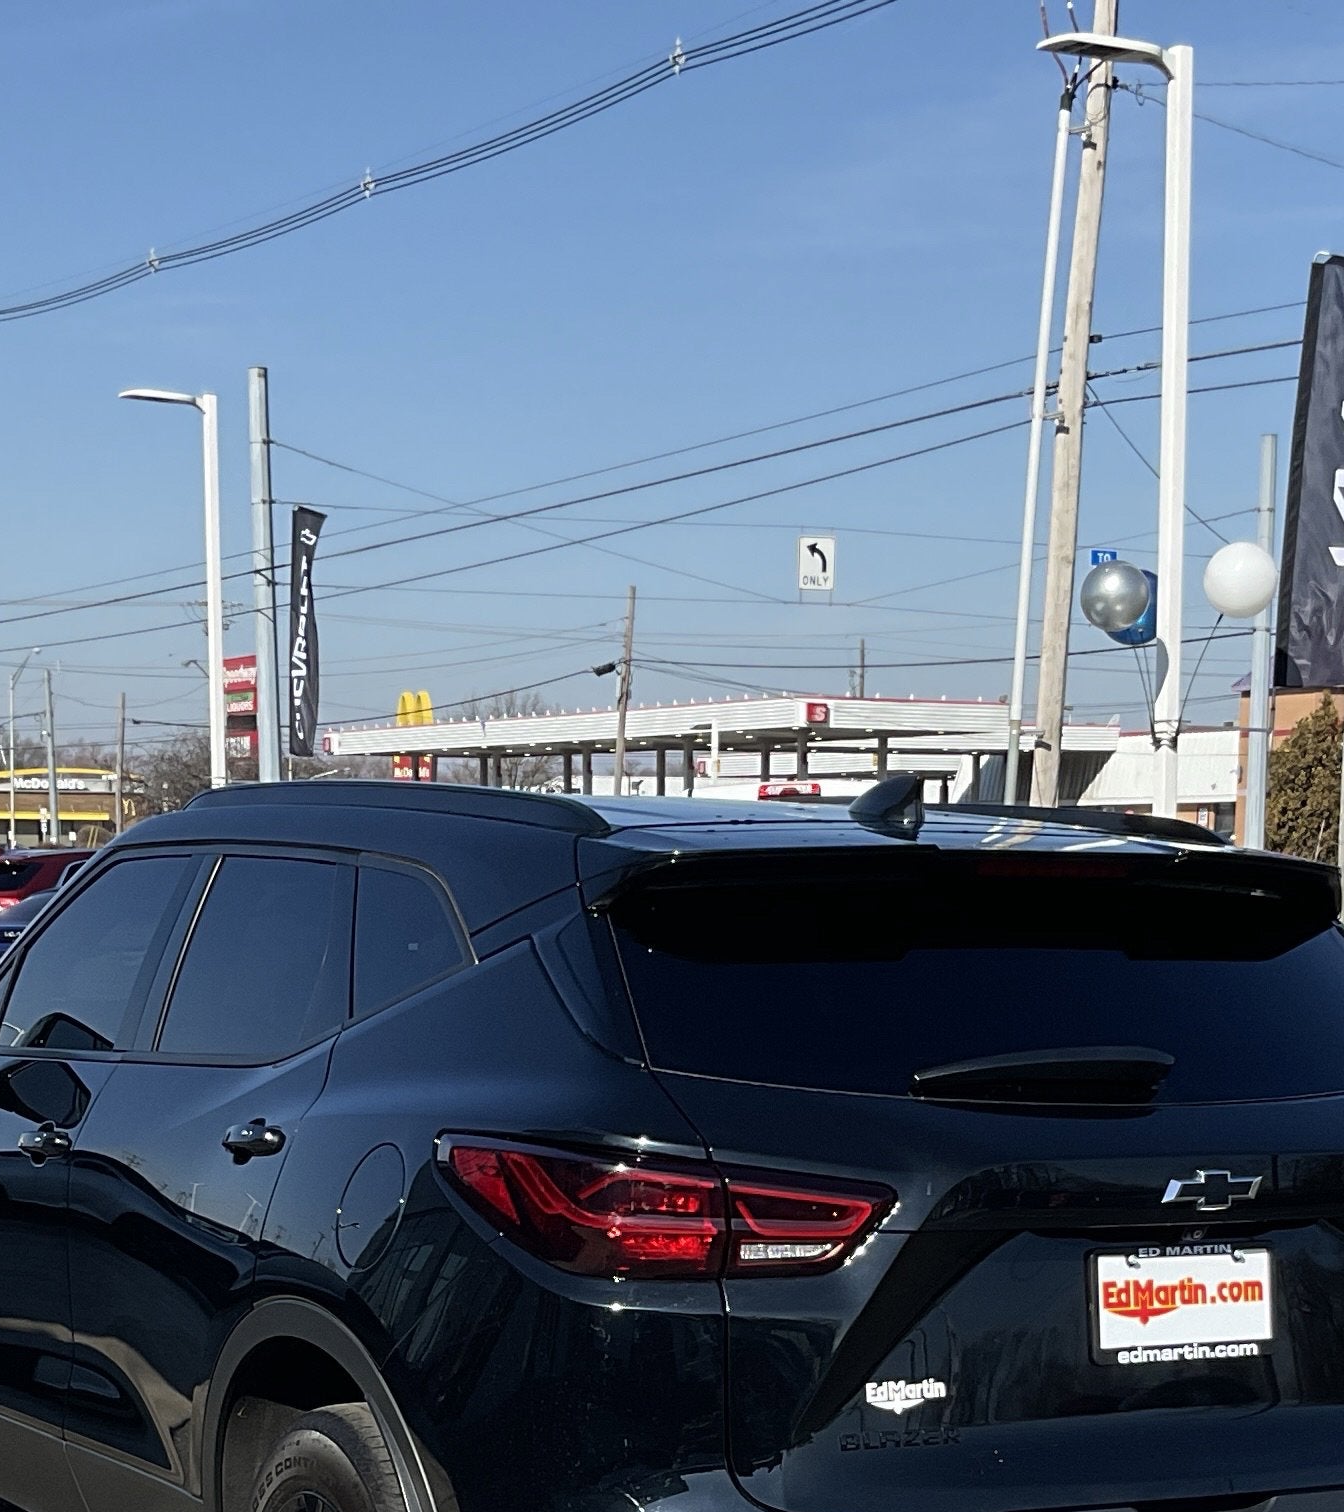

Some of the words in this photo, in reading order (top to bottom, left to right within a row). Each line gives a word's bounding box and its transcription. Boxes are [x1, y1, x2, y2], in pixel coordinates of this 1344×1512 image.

[802, 575, 830, 586] ONLY
[394, 767, 430, 777] McDold's
[13, 777, 85, 789] McDoald's
[1138, 1247, 1160, 1258] ED
[1166, 1244, 1232, 1256] MARTIN
[1102, 1277, 1263, 1312] EdMartin.com
[1117, 1343, 1258, 1364] edmartin.com
[866, 1378, 946, 1404] EdMartin
[839, 1426, 961, 1451] BLAZER
